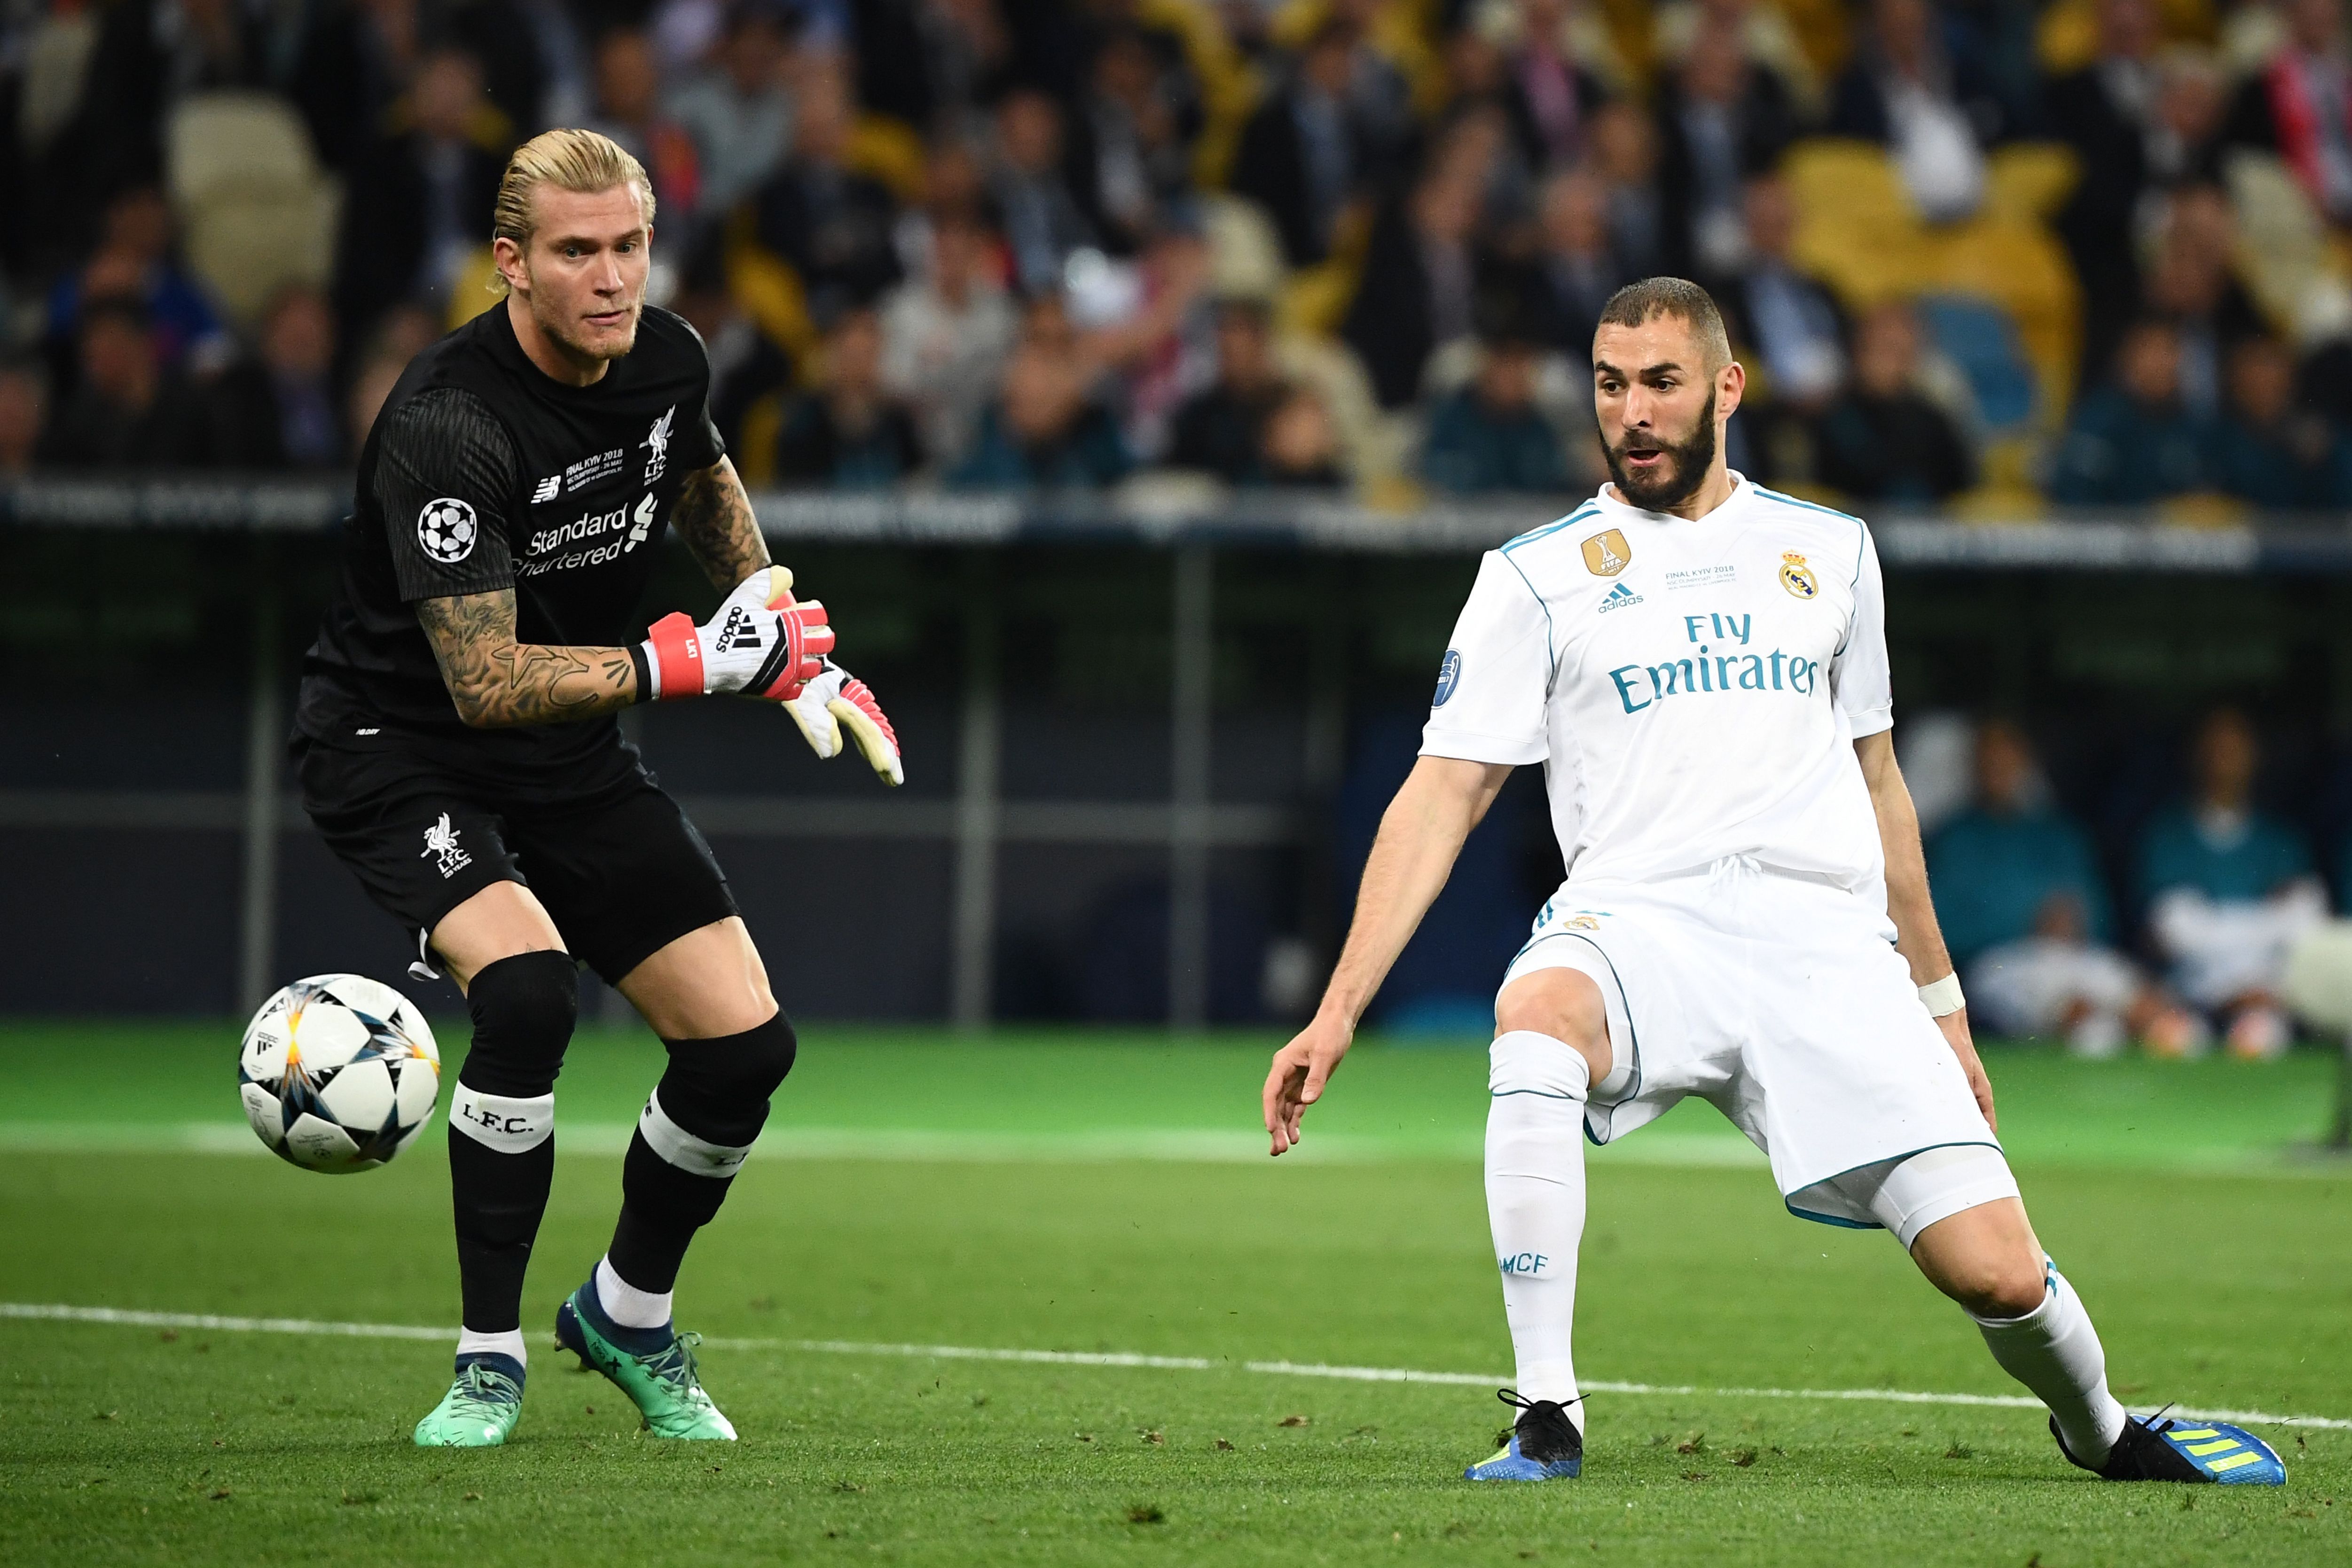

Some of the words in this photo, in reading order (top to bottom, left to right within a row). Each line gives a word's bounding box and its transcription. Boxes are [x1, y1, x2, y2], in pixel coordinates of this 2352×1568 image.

[566, 461, 584, 478] FINAL
[584, 454, 602, 469] KYIV
[603, 448, 623, 462] 2018
[525, 502, 628, 556] Standard
[1600, 557, 1622, 571] FIFA
[1692, 568, 1711, 576] KYIV
[1599, 595, 1644, 614] adidas
[716, 606, 743, 653] adidas
[1684, 613, 1751, 645] Fly
[1608, 645, 1818, 714] Emirates
[452, 857, 472, 872] YEARS
[463, 1103, 534, 1134] L.F.C.
